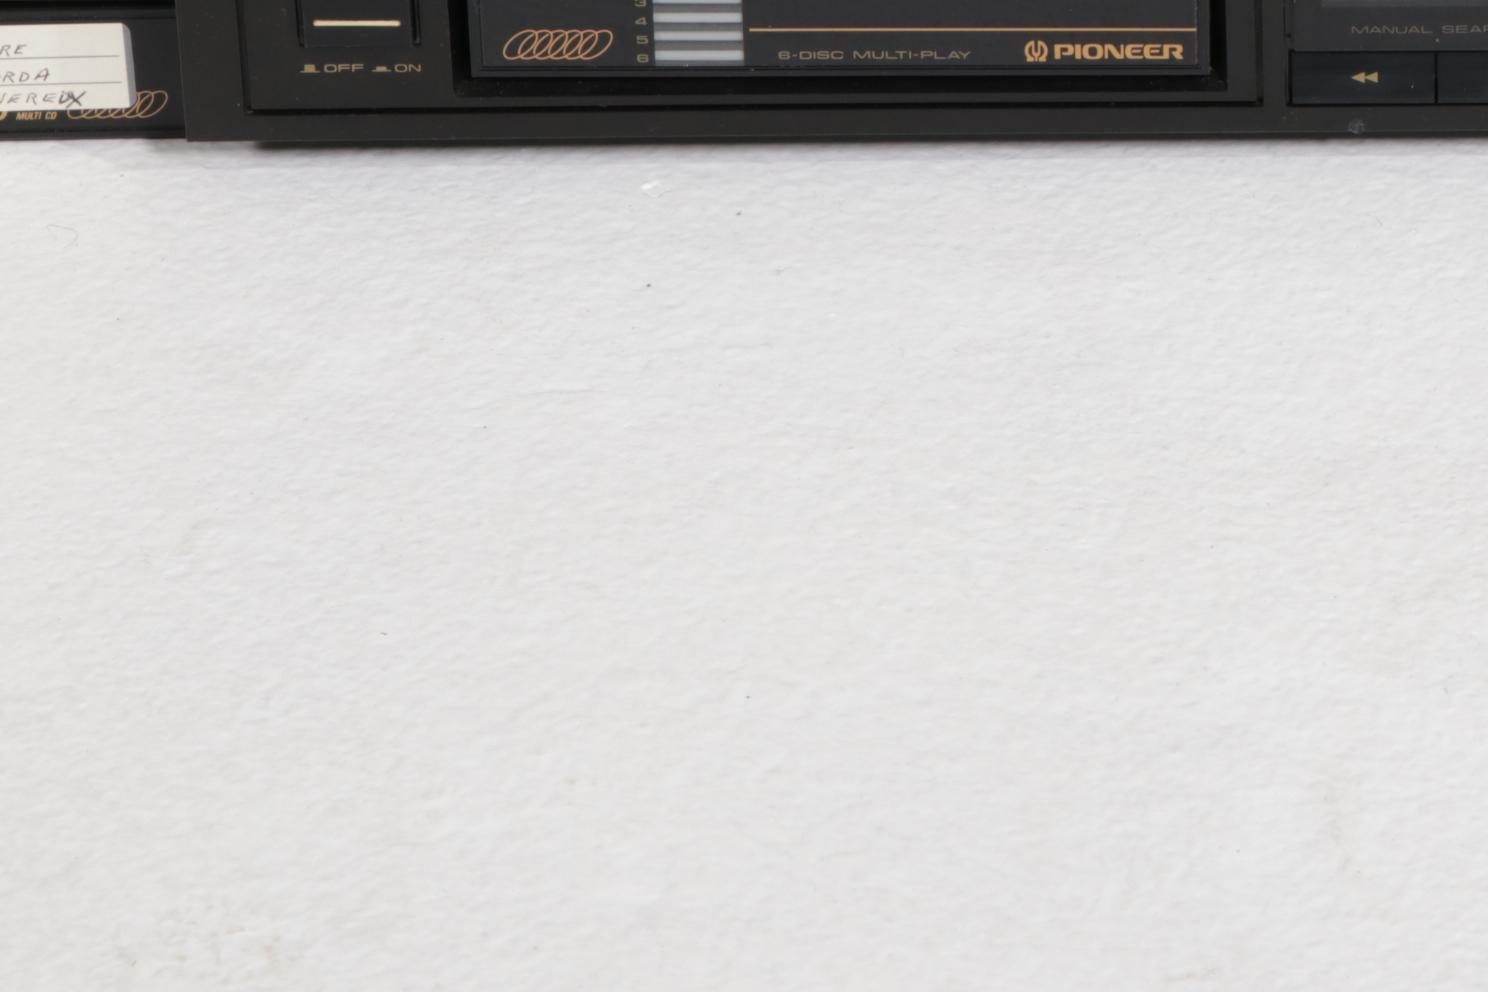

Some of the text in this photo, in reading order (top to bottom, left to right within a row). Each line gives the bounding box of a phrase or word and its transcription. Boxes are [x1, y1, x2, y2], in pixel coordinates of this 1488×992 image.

[1351, 24, 1433, 35] MANUAL
[777, 43, 1184, 61] 6-DISC MULTI-PLAY PIONEER
[323, 63, 422, 73] OFF ON
